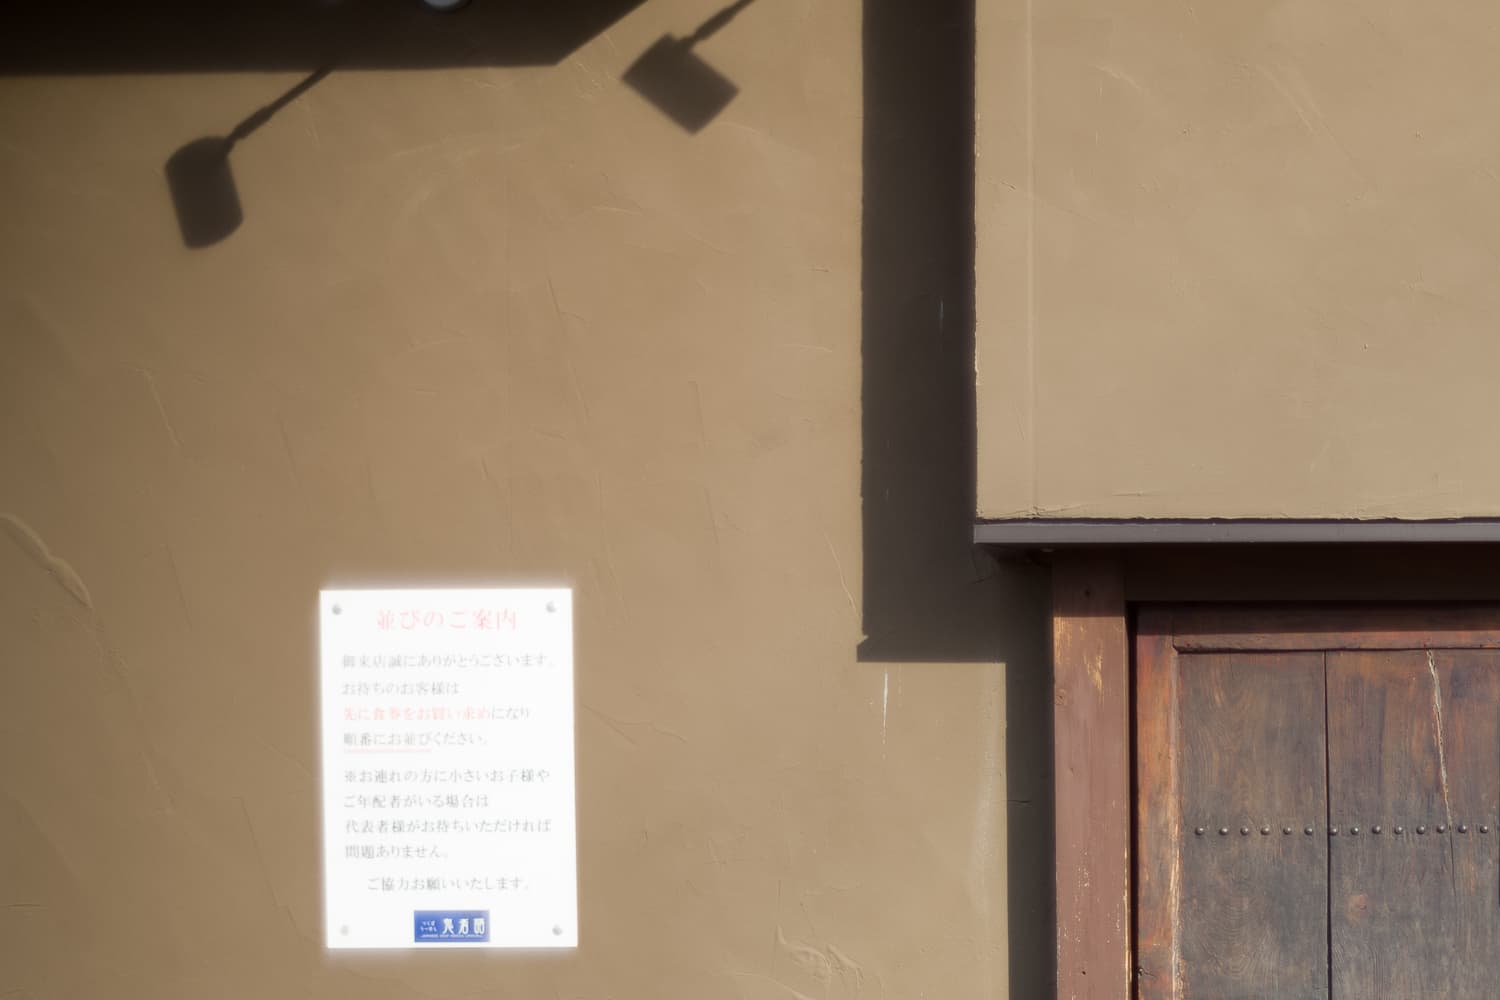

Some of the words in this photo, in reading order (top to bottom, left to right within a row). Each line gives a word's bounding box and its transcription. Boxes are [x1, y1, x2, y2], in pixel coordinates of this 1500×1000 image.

[377, 608, 518, 631] 並びのご案内
